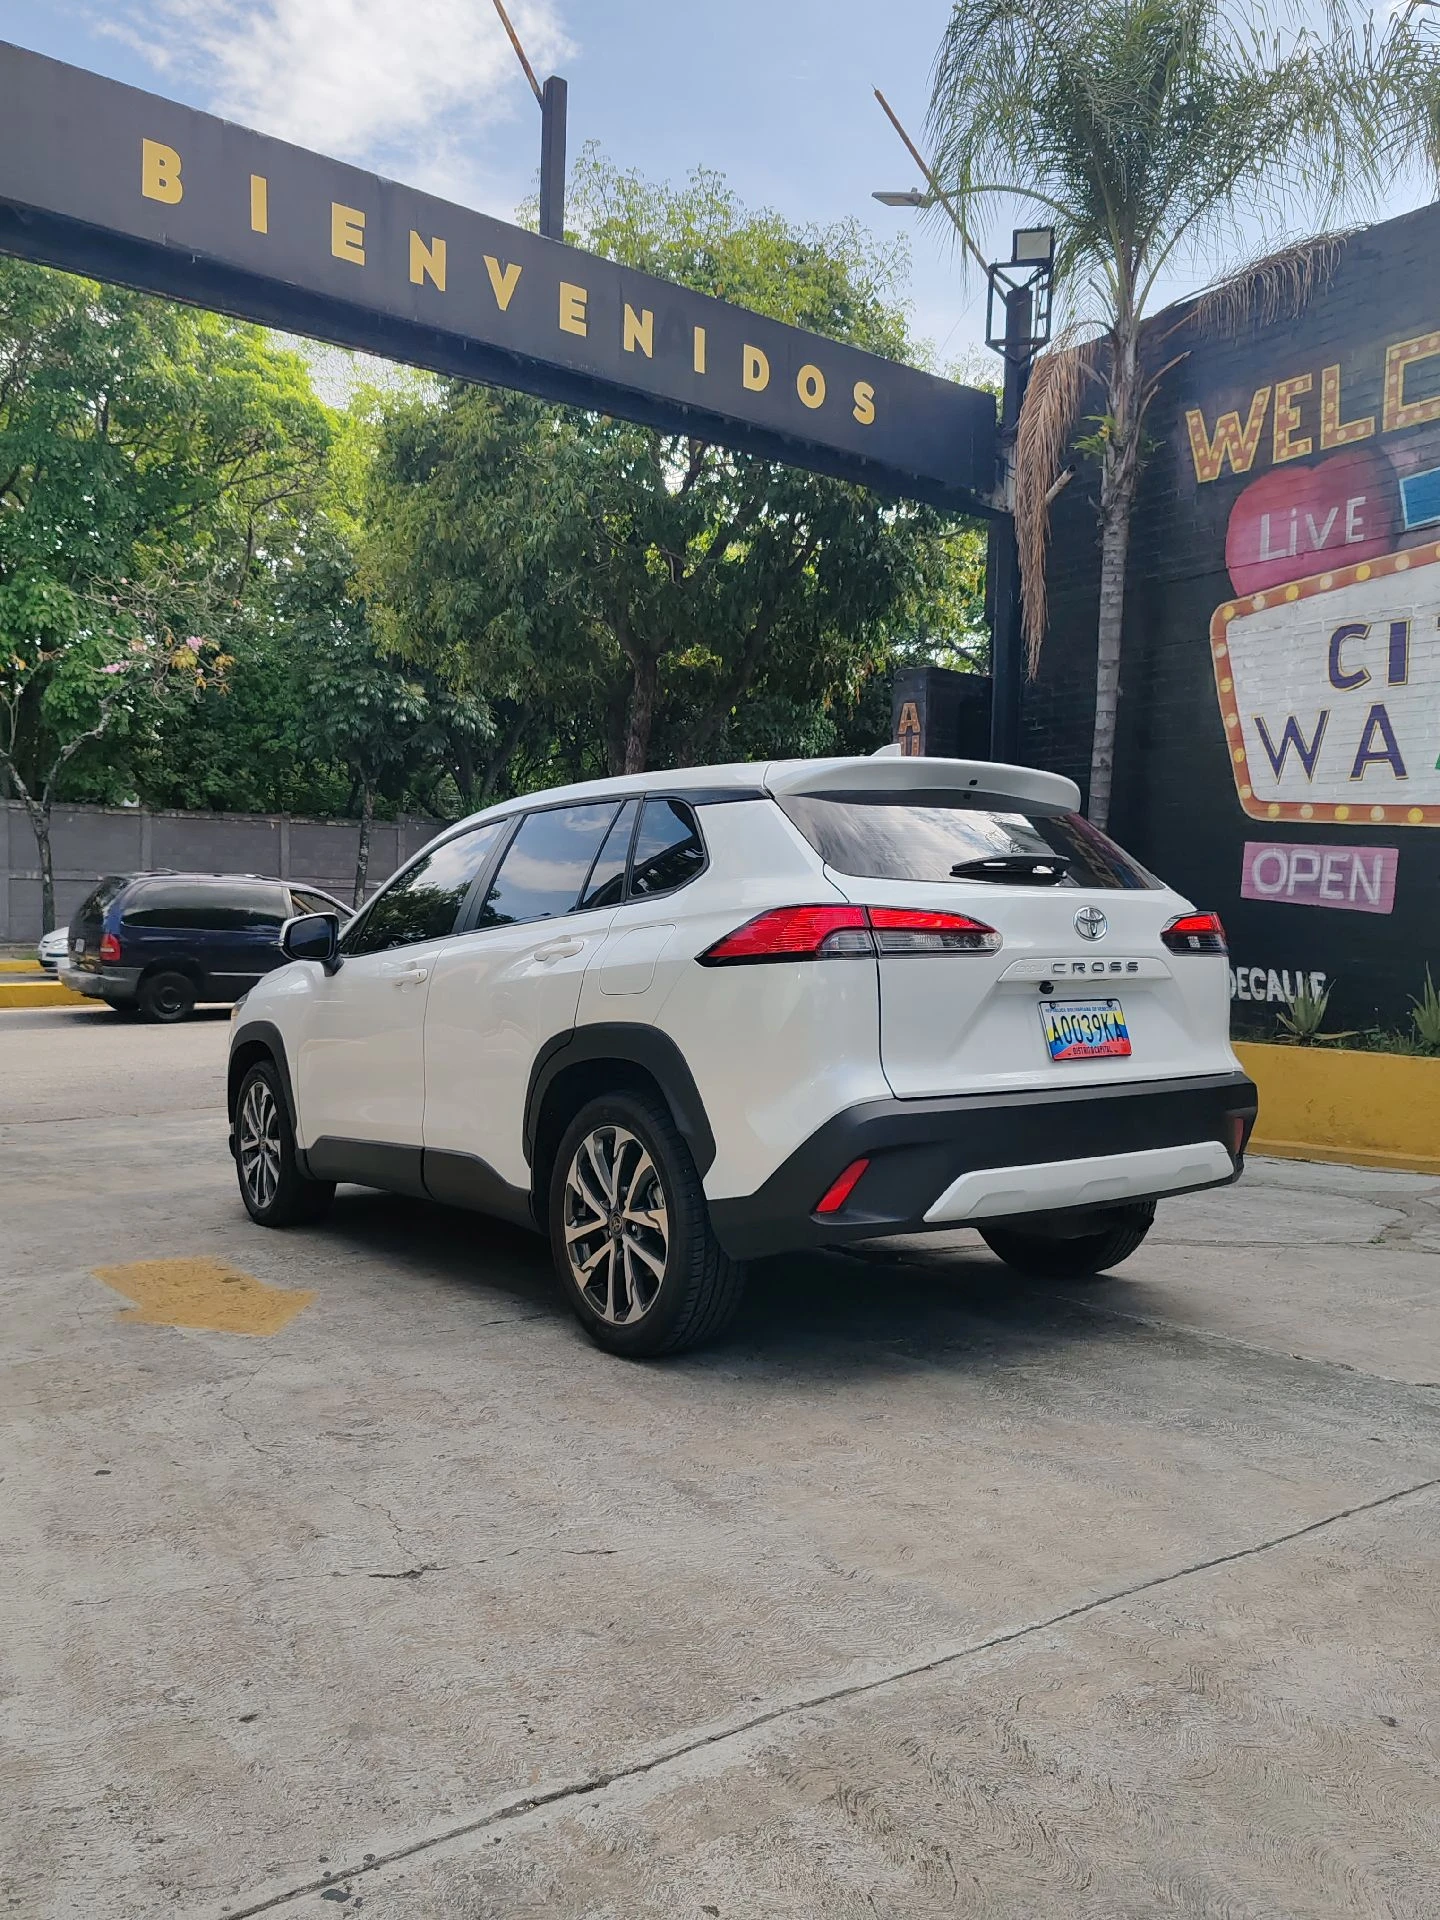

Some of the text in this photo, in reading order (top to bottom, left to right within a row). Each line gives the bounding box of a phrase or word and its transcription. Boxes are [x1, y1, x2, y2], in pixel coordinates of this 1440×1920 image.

[142, 137, 877, 427] BIENVENIDOS
[1185, 330, 1440, 483] WELC
[1329, 615, 1440, 691] CI
[1252, 848, 1383, 906] OPEN
[1051, 961, 1139, 974] CROSS
